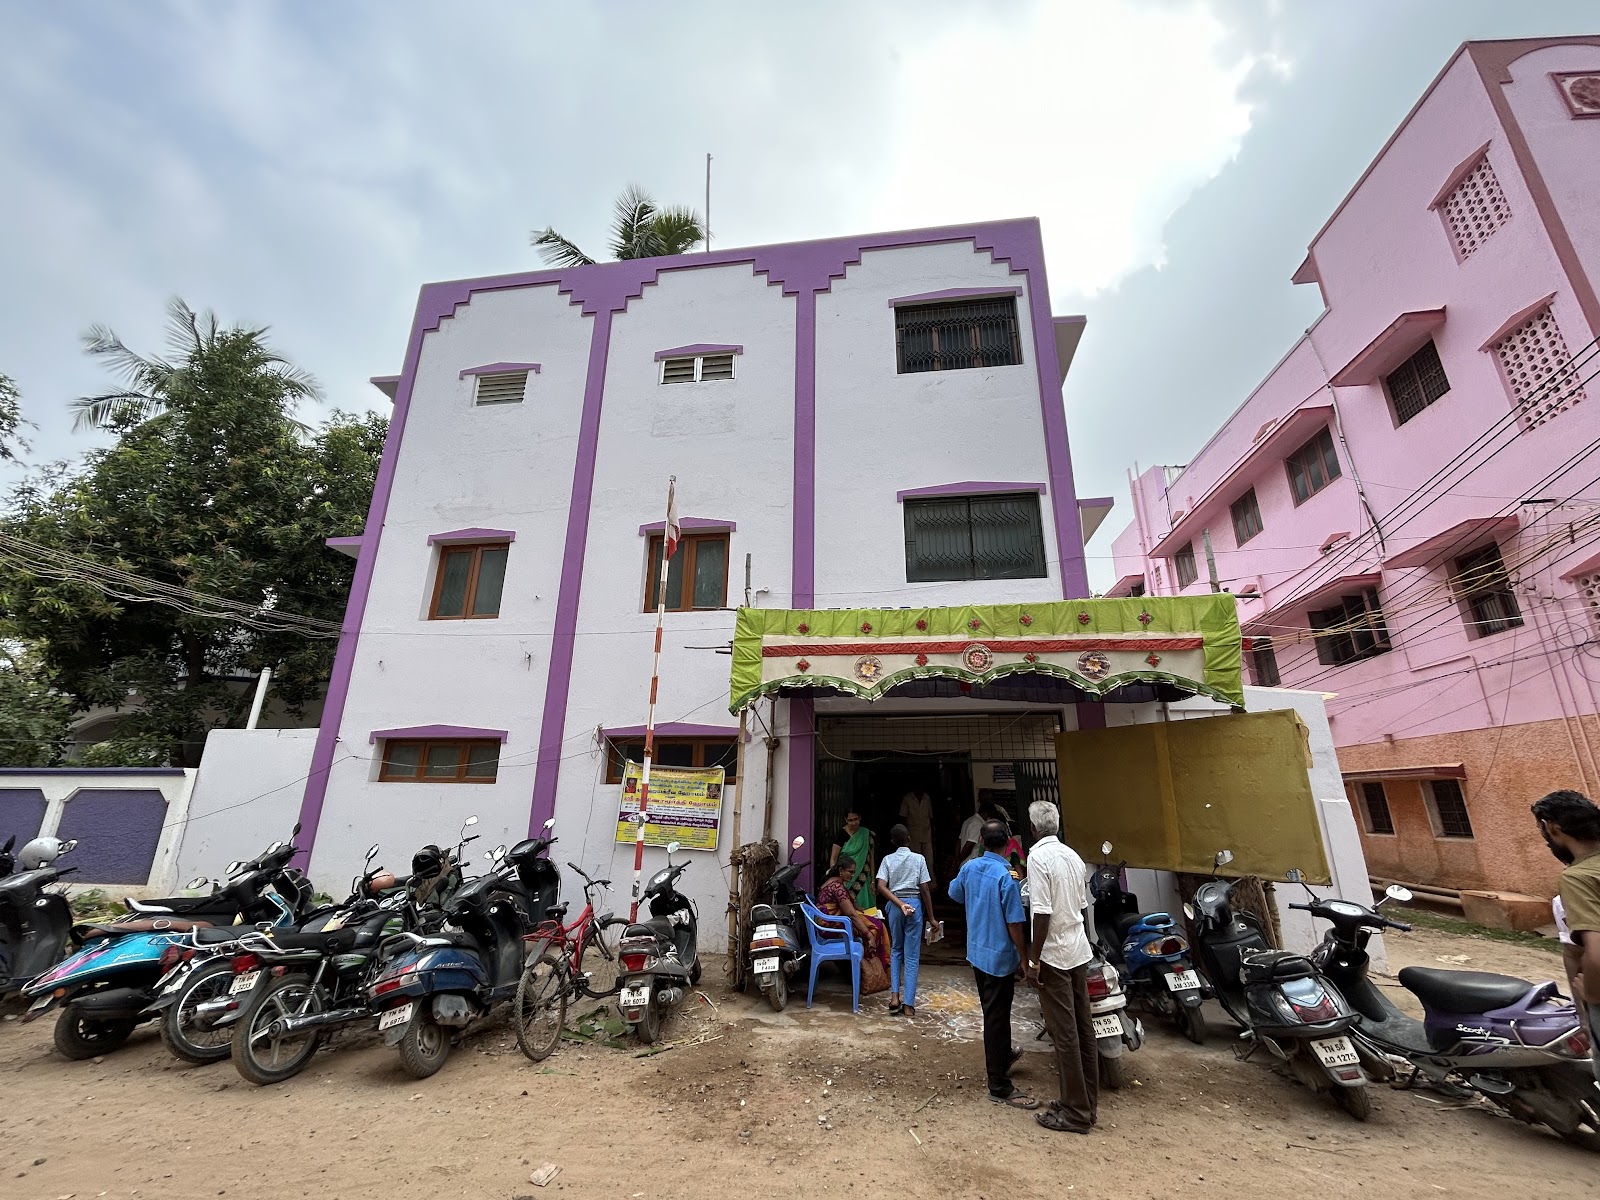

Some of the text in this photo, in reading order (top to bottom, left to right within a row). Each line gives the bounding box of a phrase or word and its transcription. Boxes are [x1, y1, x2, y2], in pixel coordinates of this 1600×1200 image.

[1103, 1026, 1119, 1034] 1201
[1456, 1023, 1491, 1040] Scooty
[1322, 1043, 1346, 1053] TN 58
[1337, 1053, 1357, 1062] 1275
